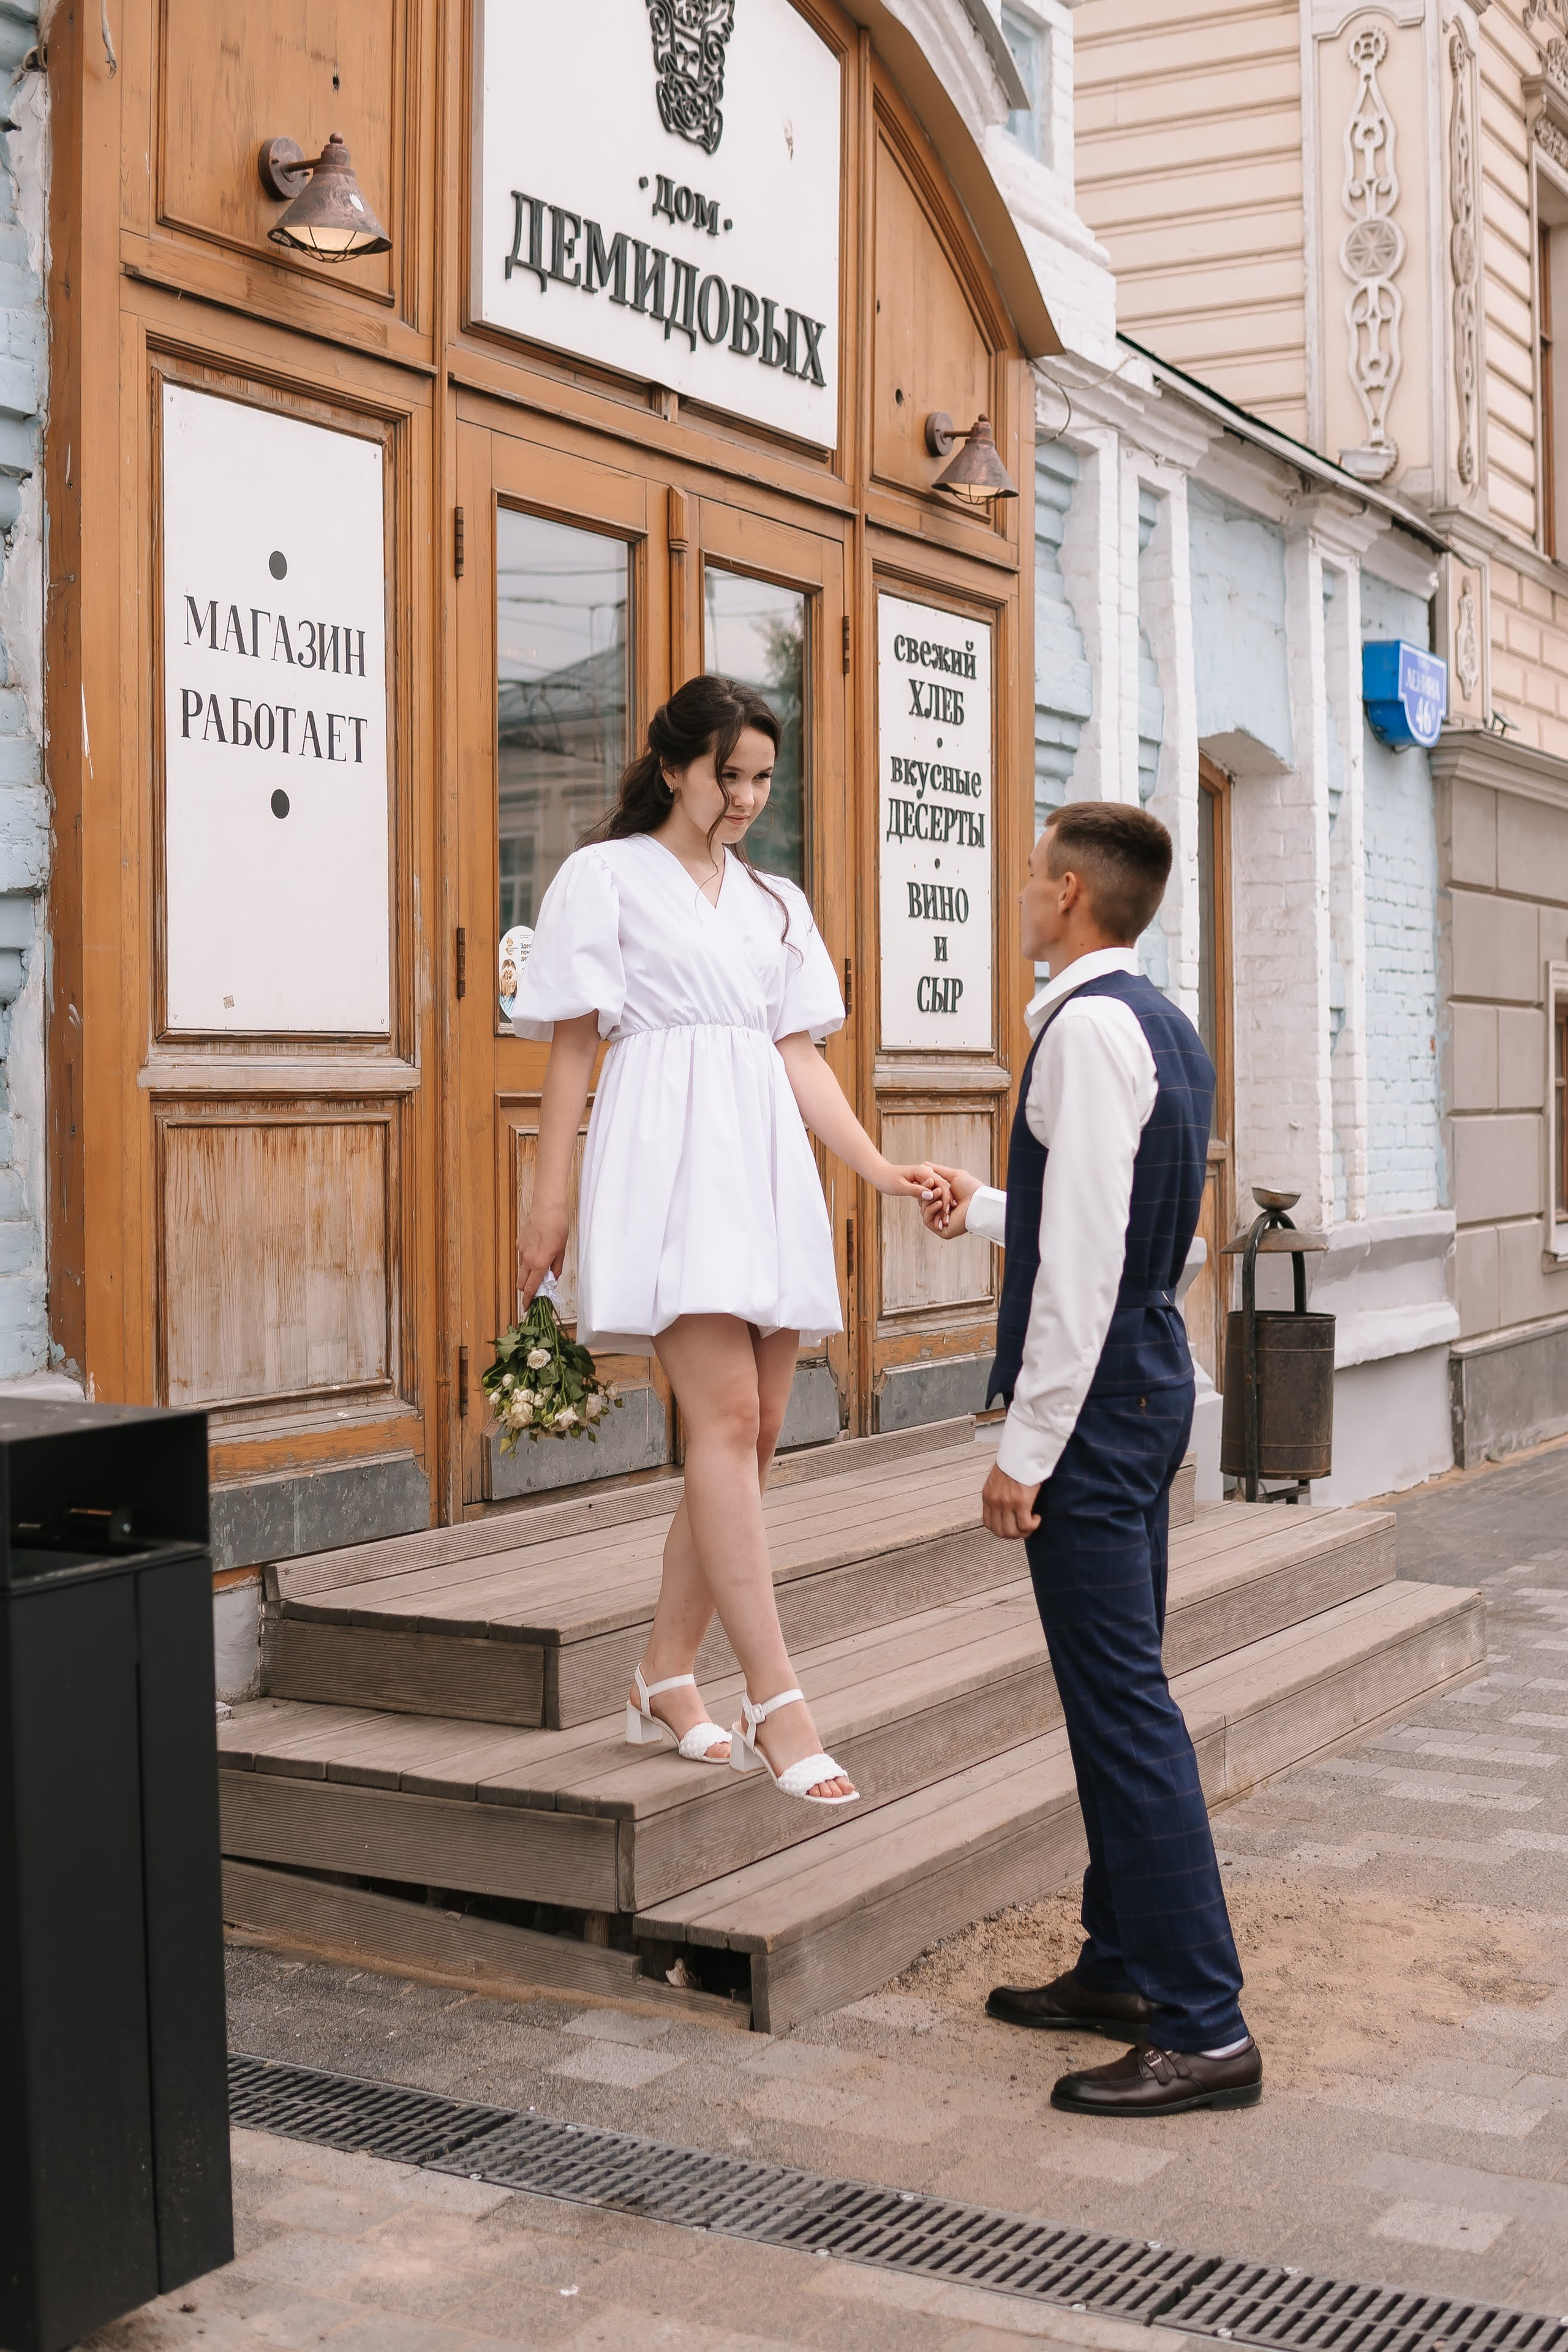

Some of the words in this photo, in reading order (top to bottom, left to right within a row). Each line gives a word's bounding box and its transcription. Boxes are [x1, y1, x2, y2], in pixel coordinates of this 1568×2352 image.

[505, 190, 827, 388] ДЕМИДОВЫХ
[184, 595, 366, 677] МАГАЗИН
[894, 635, 977, 679] свежий
[908, 678, 965, 725] ХЛЕБ
[180, 688, 368, 763] РАБОТАЕТ
[891, 756, 982, 799] вкусные
[887, 798, 985, 847] ДЕСЕРТЫ
[907, 882, 969, 923] ВИНО
[917, 976, 963, 1013] СЫР
